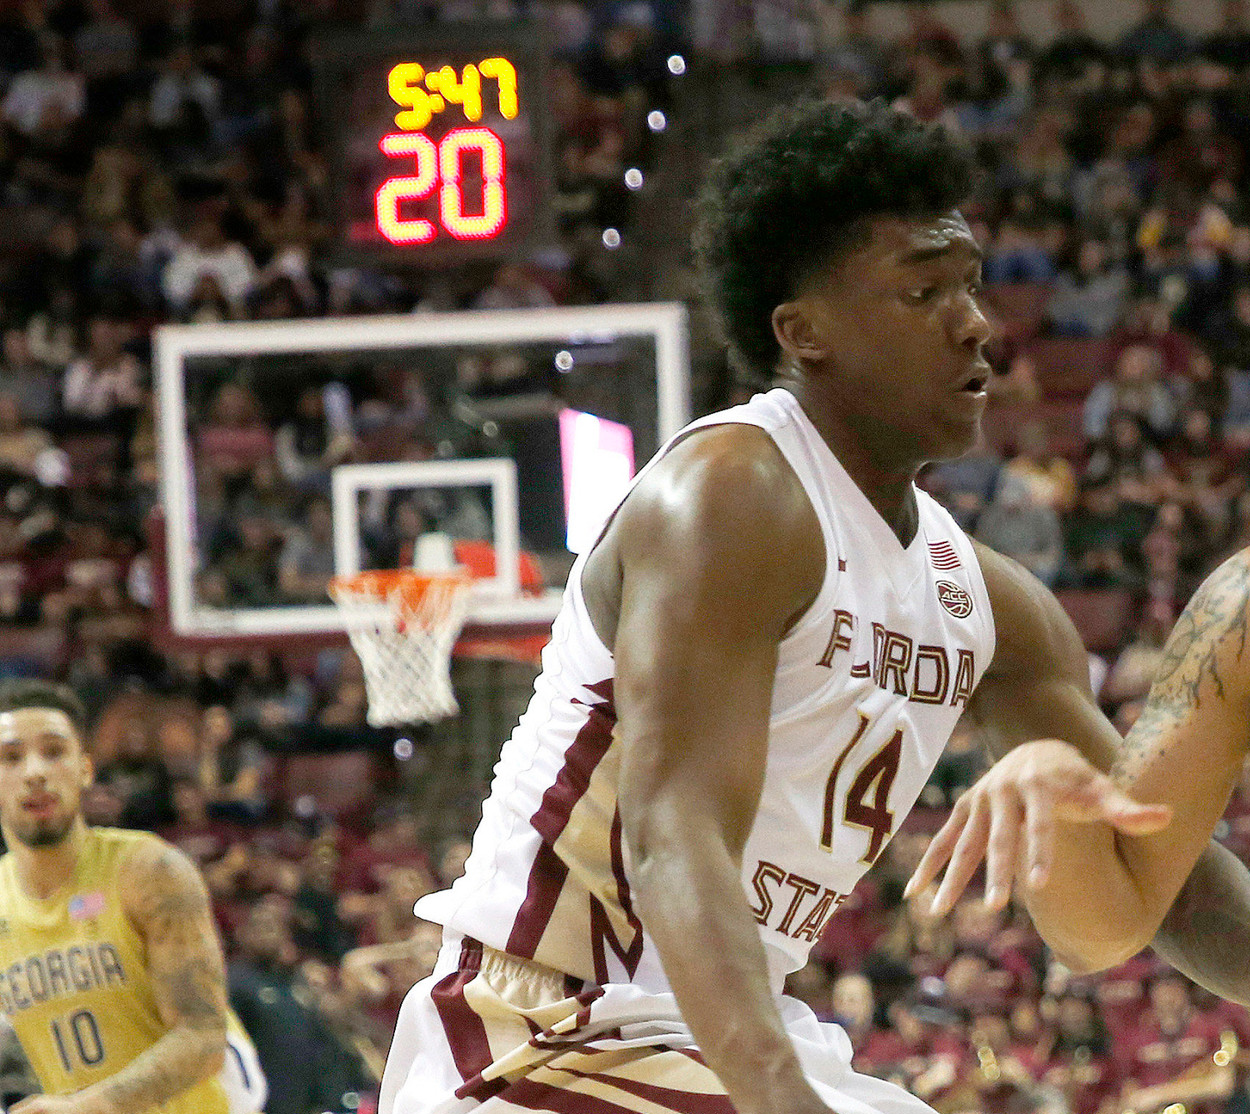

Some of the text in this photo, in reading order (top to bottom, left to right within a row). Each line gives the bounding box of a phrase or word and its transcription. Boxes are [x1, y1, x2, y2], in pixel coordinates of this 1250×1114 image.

[388, 57, 518, 130] 5:47
[376, 128, 507, 244] 20
[819, 708, 903, 866] 14
[748, 860, 850, 943] STA
[51, 1008, 104, 1073] 10
